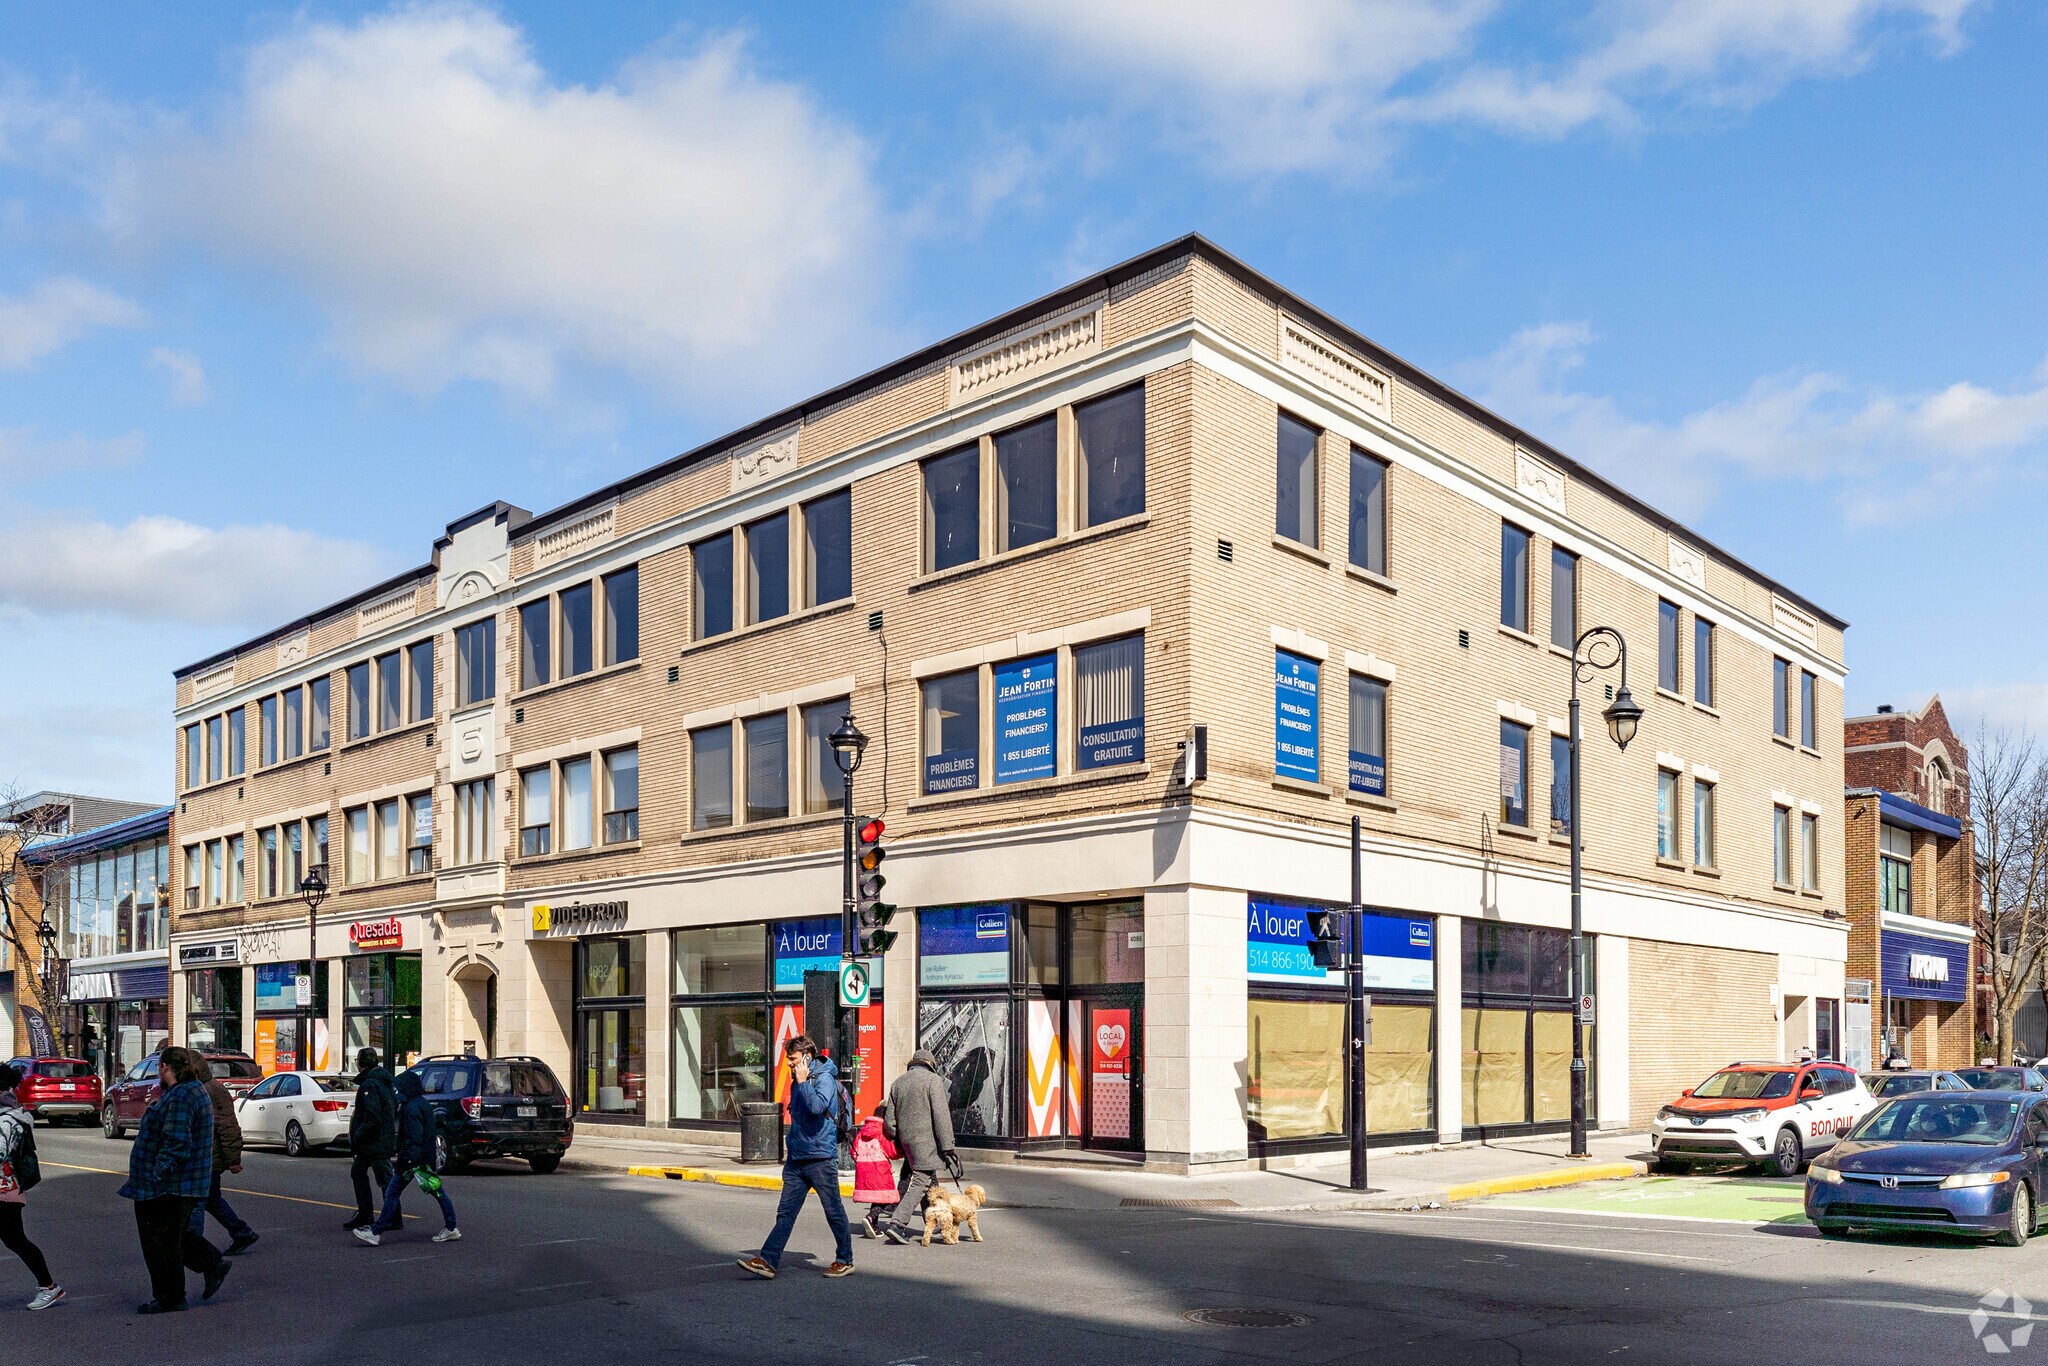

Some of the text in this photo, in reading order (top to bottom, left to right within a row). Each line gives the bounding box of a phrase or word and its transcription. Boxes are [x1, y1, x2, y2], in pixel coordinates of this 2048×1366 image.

[999, 677, 1056, 698] JEAN FORTIN
[1276, 672, 1316, 693] JEAN FORTIN
[1006, 708, 1047, 723] PROBLÈMES
[1281, 702, 1311, 717] PROBLÈMES
[1005, 723, 1048, 738] FINANCIERS?
[1280, 717, 1312, 733] FINANCIERS?
[1083, 726, 1143, 747] CONSULTATION
[1007, 750, 1020, 761] 855
[1021, 743, 1050, 759] LIBERTÉ
[1094, 745, 1133, 761] GRATUITE
[1281, 743, 1291, 753] 855
[1291, 744, 1315, 758] LIBERTÉ
[931, 758, 974, 775] PROBLÈMES
[1349, 760, 1384, 777] ANFORTIN.COM
[929, 774, 976, 791] FINANCIERS?
[1349, 774, 1381, 789] -877-LIBERTÉ
[551, 901, 628, 925] VIDÉOTRON
[1249, 903, 1303, 938] À louer
[350, 917, 399, 943] Quesada
[980, 919, 1003, 928] Colliers
[1412, 926, 1428, 937] Colliers
[779, 927, 831, 952] À louer
[1130, 935, 1143, 943] 4086
[1250, 949, 1269, 967] 514
[589, 965, 609, 978] 4082
[780, 964, 797, 980] 514
[858, 1024, 877, 1034] ngton
[1099, 1032, 1123, 1040] LOCAL
